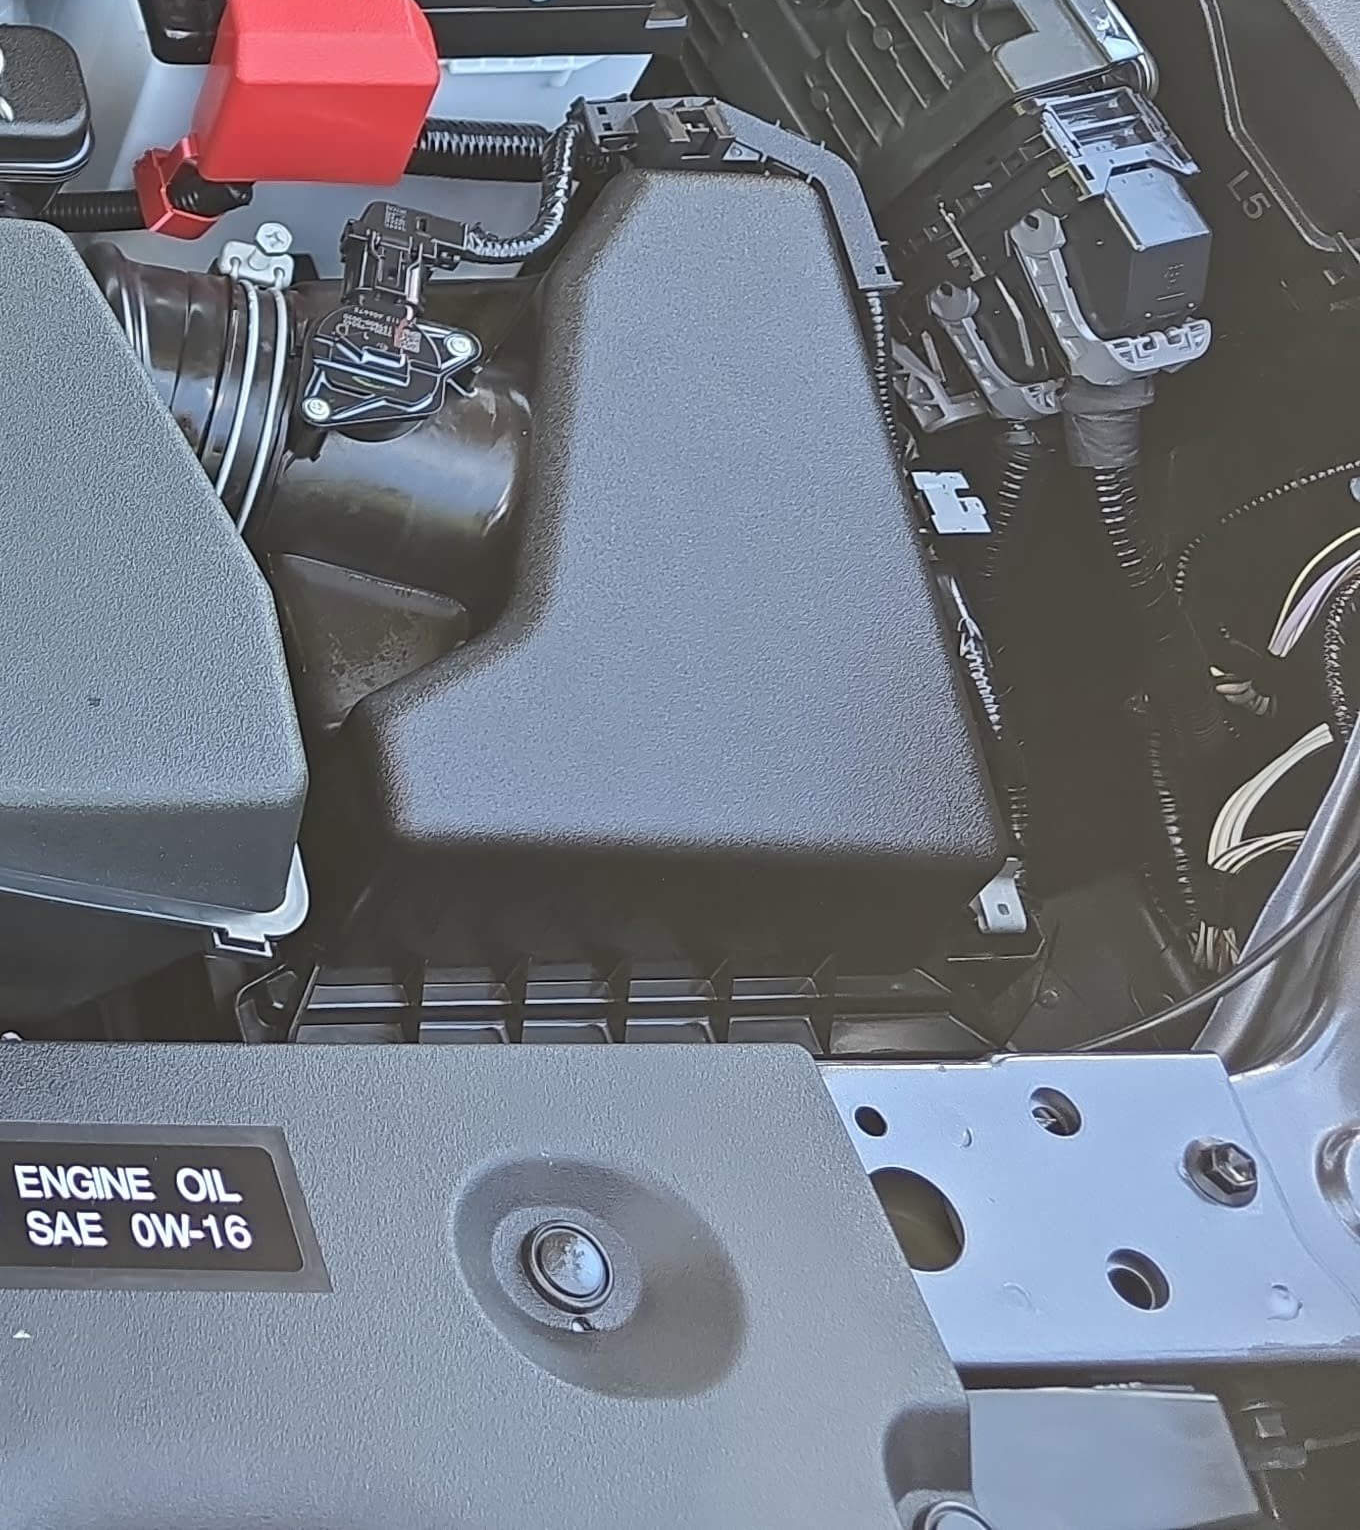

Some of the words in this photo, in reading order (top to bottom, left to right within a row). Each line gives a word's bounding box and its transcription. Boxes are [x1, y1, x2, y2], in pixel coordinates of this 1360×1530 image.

[1227, 170, 1271, 220] L5
[14, 1164, 156, 1202] ENGINE
[175, 1166, 242, 1203] OIL
[26, 1212, 108, 1248] SAE
[131, 1214, 253, 1250] 0W-16
